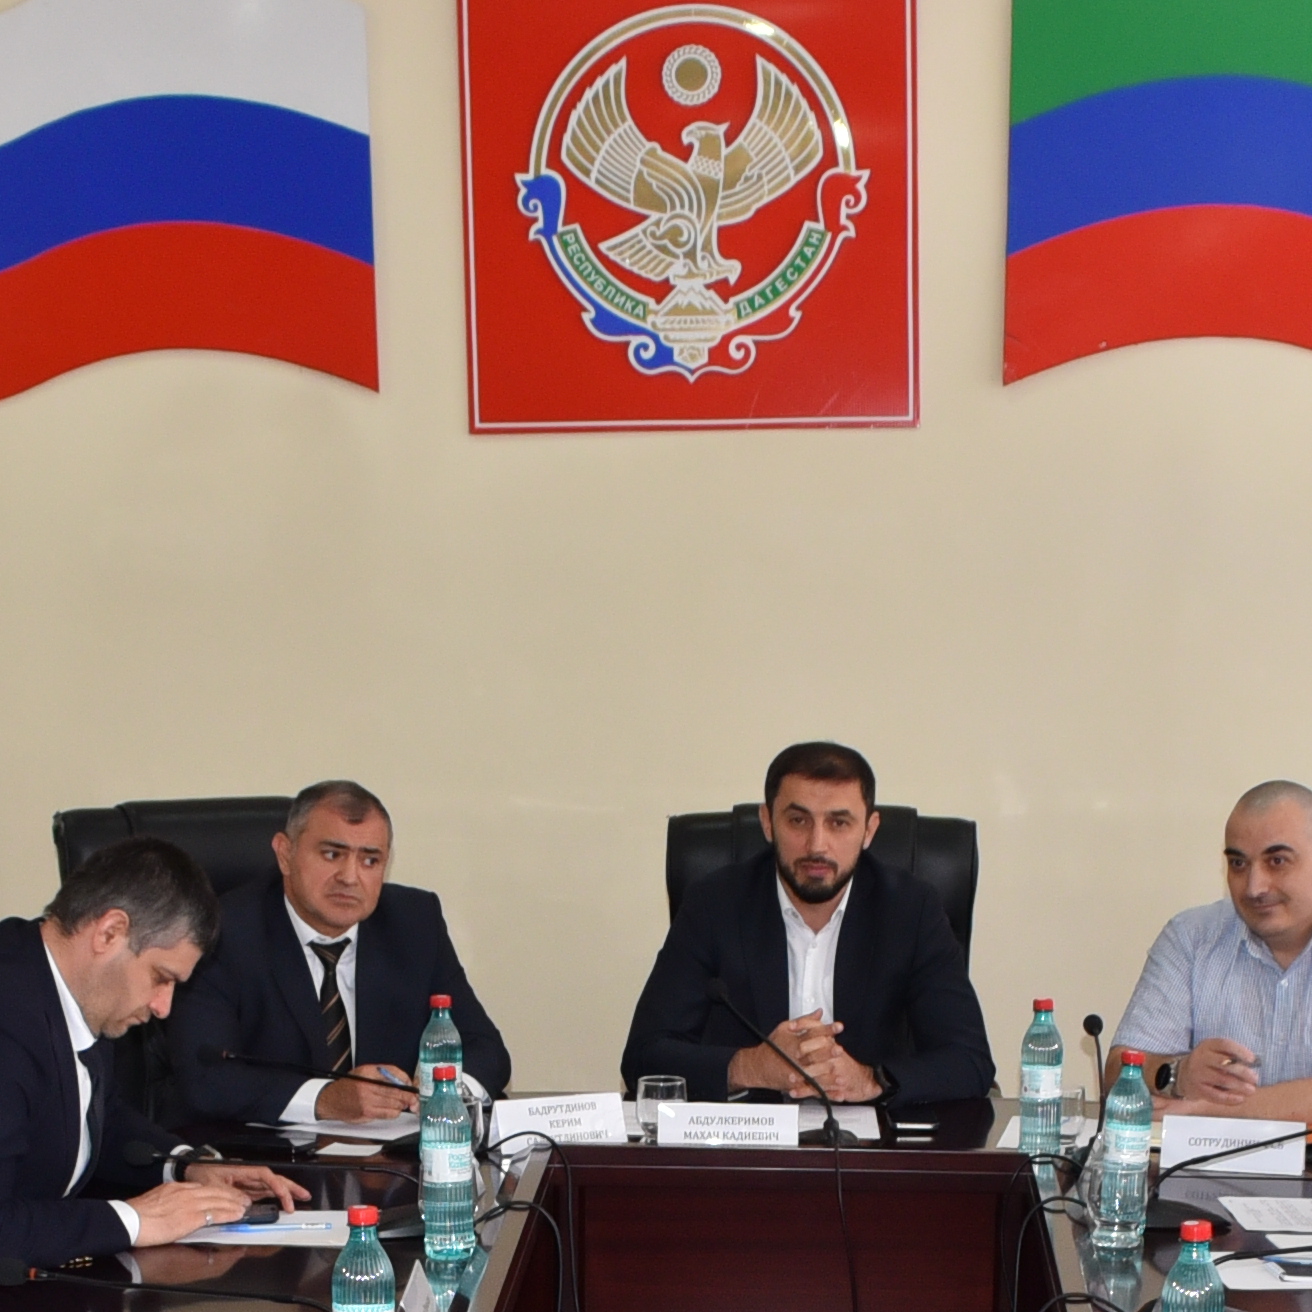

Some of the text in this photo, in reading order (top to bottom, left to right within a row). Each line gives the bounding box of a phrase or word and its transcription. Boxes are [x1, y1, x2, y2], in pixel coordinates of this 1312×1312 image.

[563, 233, 645, 318] РЕСПУБЛИКА
[739, 231, 822, 318] ДАГЕСТАН
[528, 1101, 597, 1116] БАДРУТДИНОВ
[549, 1117, 582, 1129] КЕРИМ
[688, 1115, 775, 1126] АБДУЛКЕРИМОВ
[684, 1131, 779, 1141] МАХАЧ КАДИЕВИЧ
